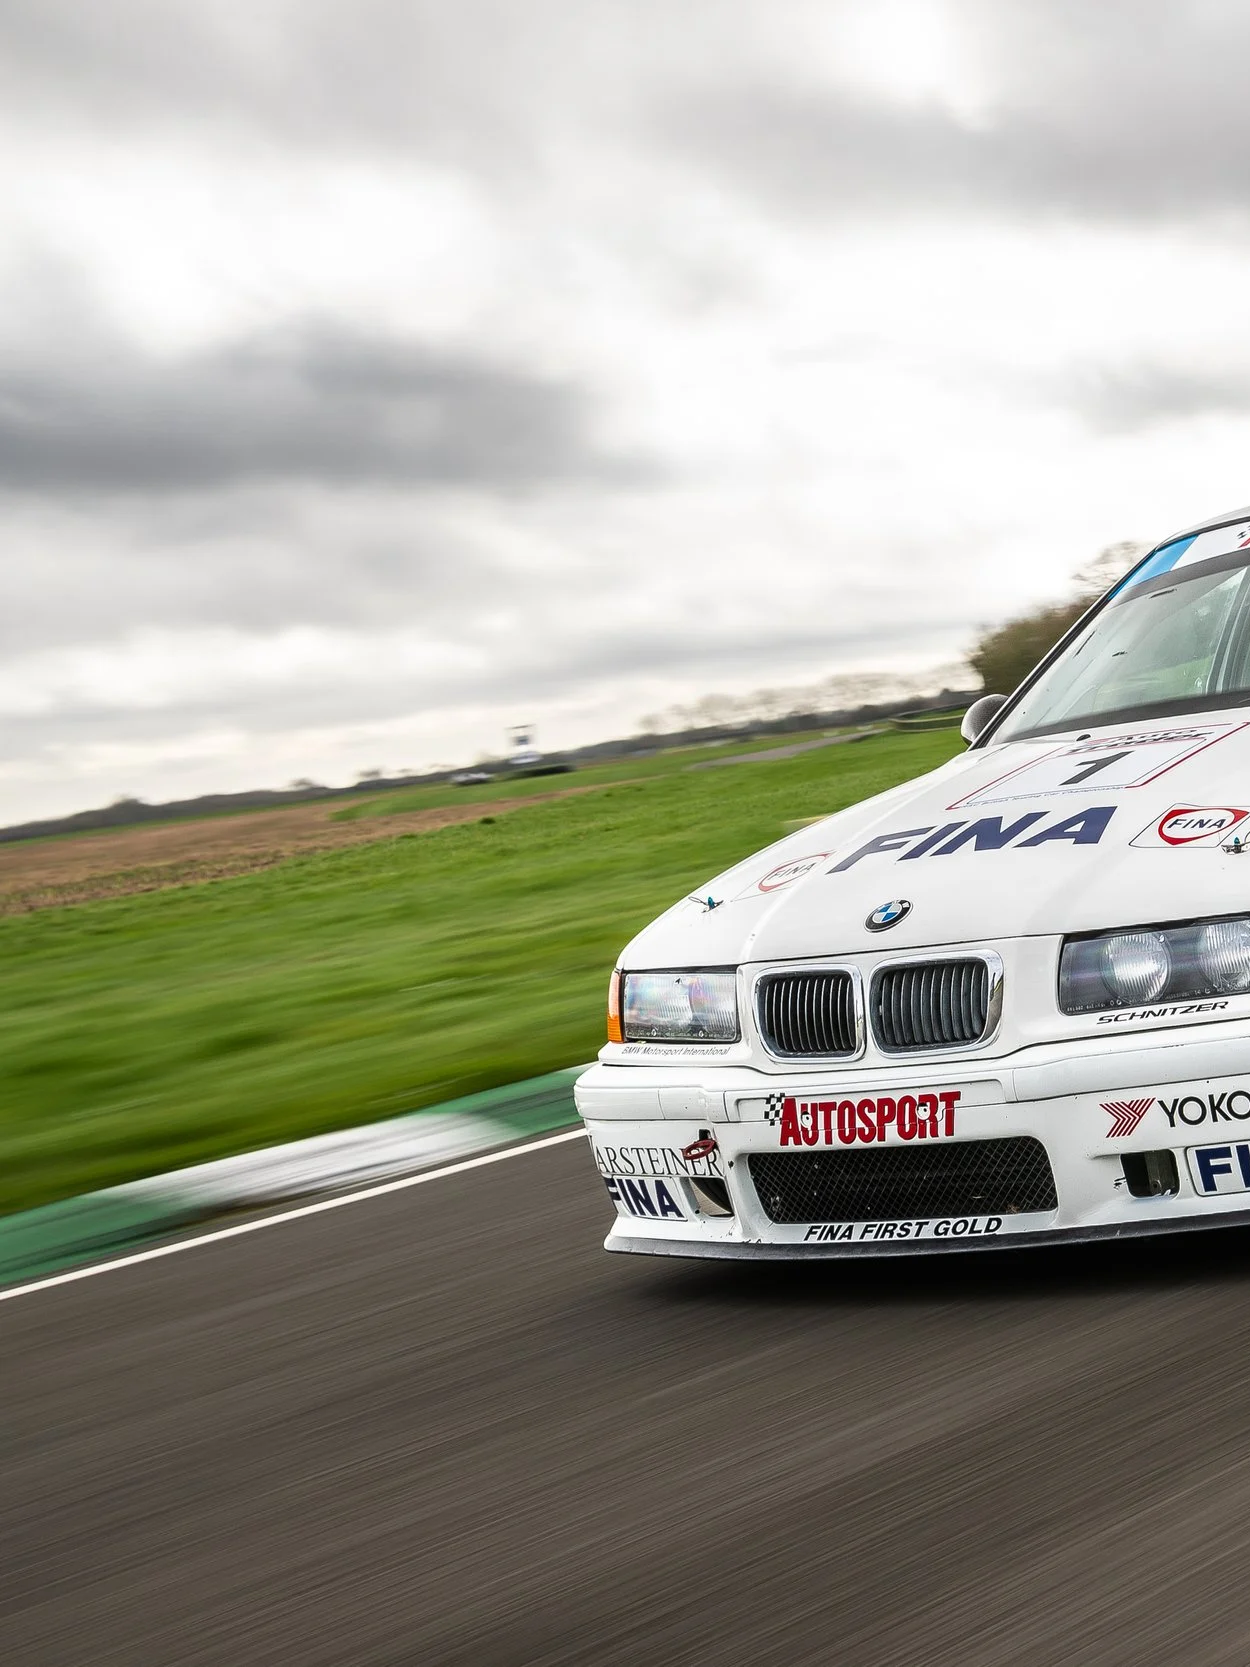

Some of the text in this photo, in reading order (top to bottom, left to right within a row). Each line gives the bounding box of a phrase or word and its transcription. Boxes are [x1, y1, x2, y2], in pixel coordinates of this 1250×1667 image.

[1059, 750, 1135, 786] 1
[1167, 819, 1226, 829] FINA
[825, 805, 1118, 875] FINA
[1096, 1001, 1229, 1025] SCHNITZER
[642, 1046, 683, 1056] Motorsport
[682, 1046, 731, 1056] International
[780, 1091, 961, 1146] AUTOSPORT
[803, 1217, 1003, 1242] FINA FIRST GOLD
